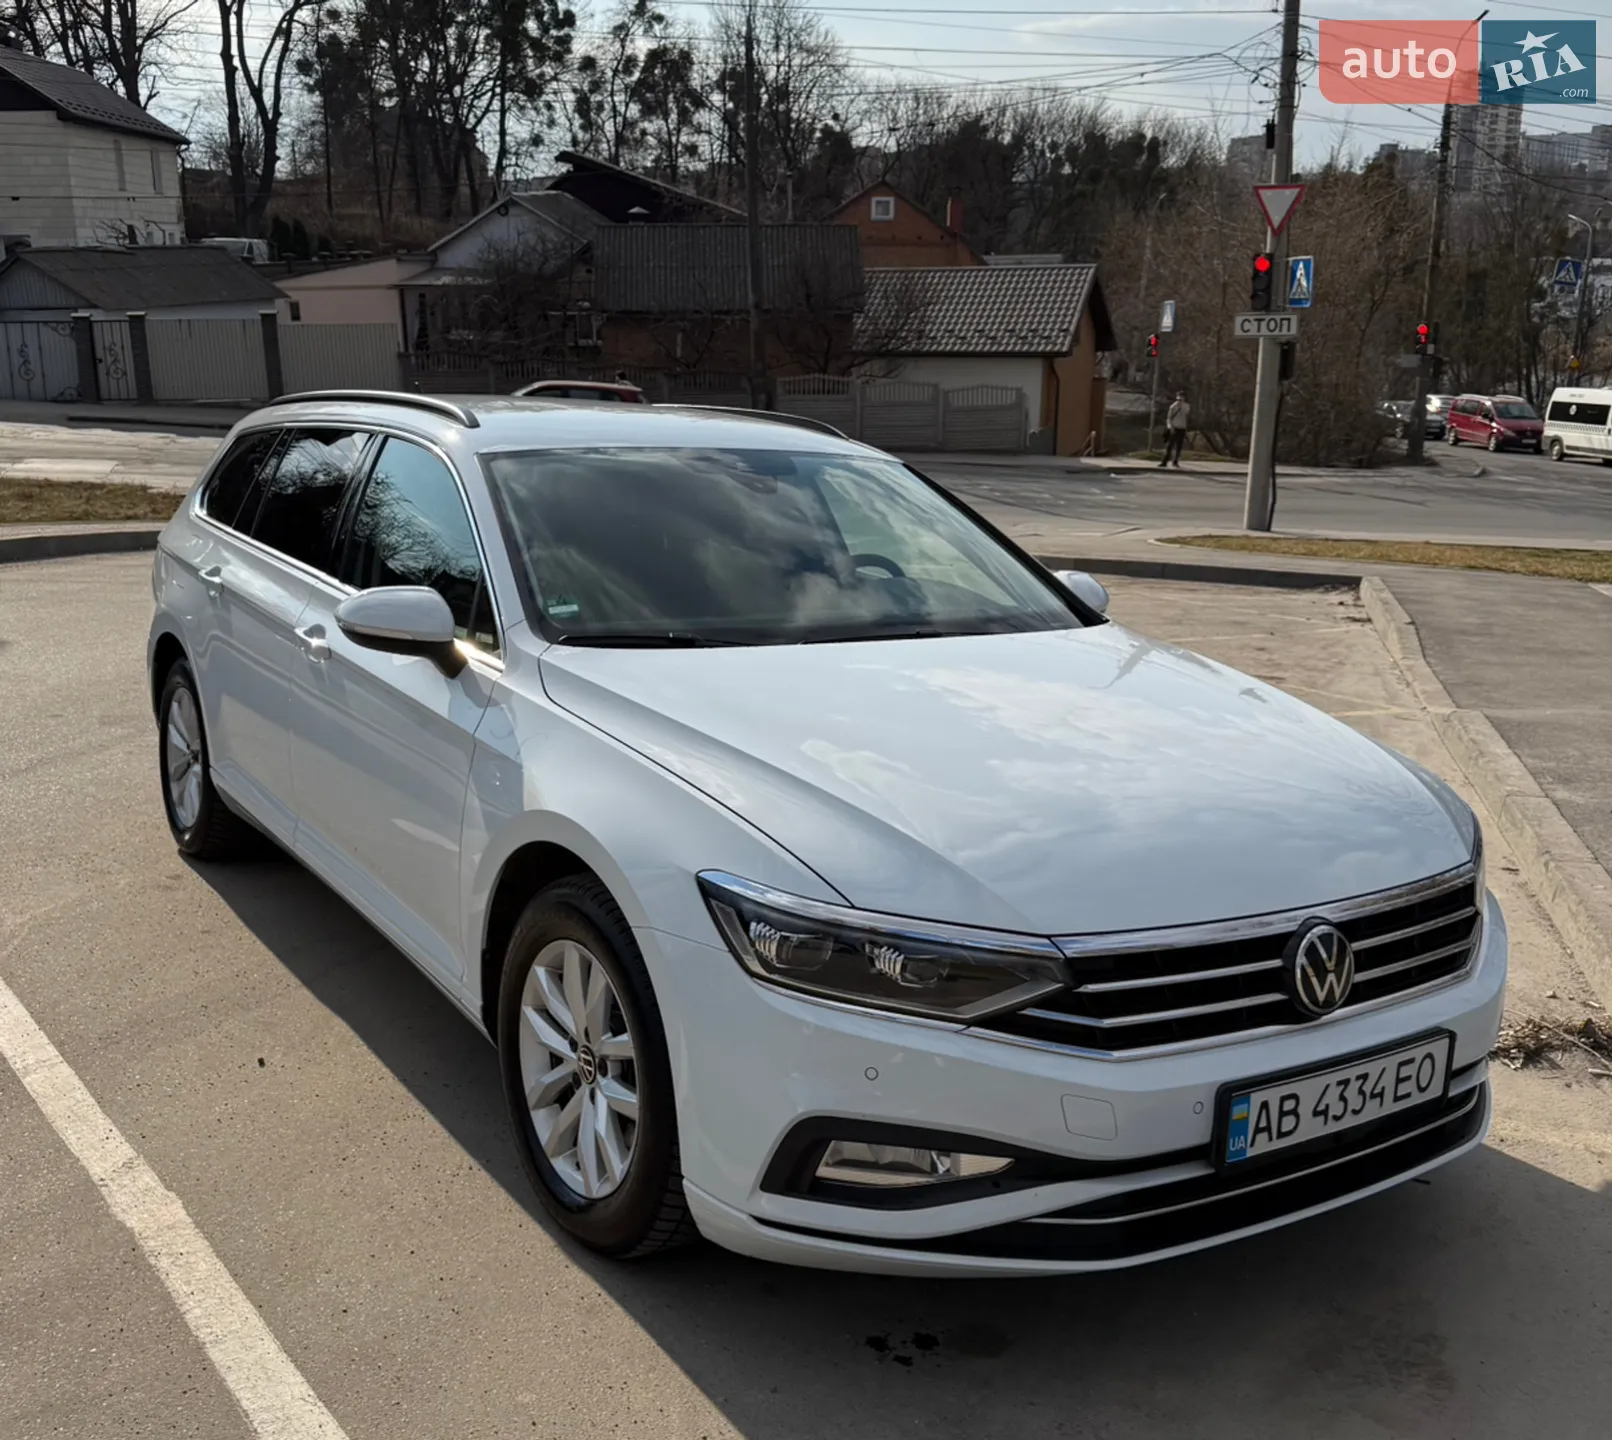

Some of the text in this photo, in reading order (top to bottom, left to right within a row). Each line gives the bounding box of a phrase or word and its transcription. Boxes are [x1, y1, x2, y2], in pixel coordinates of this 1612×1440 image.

[1240, 317, 1292, 333] СТОП
[1249, 1092, 1301, 1148] AB
[1229, 1135, 1246, 1151] UA
